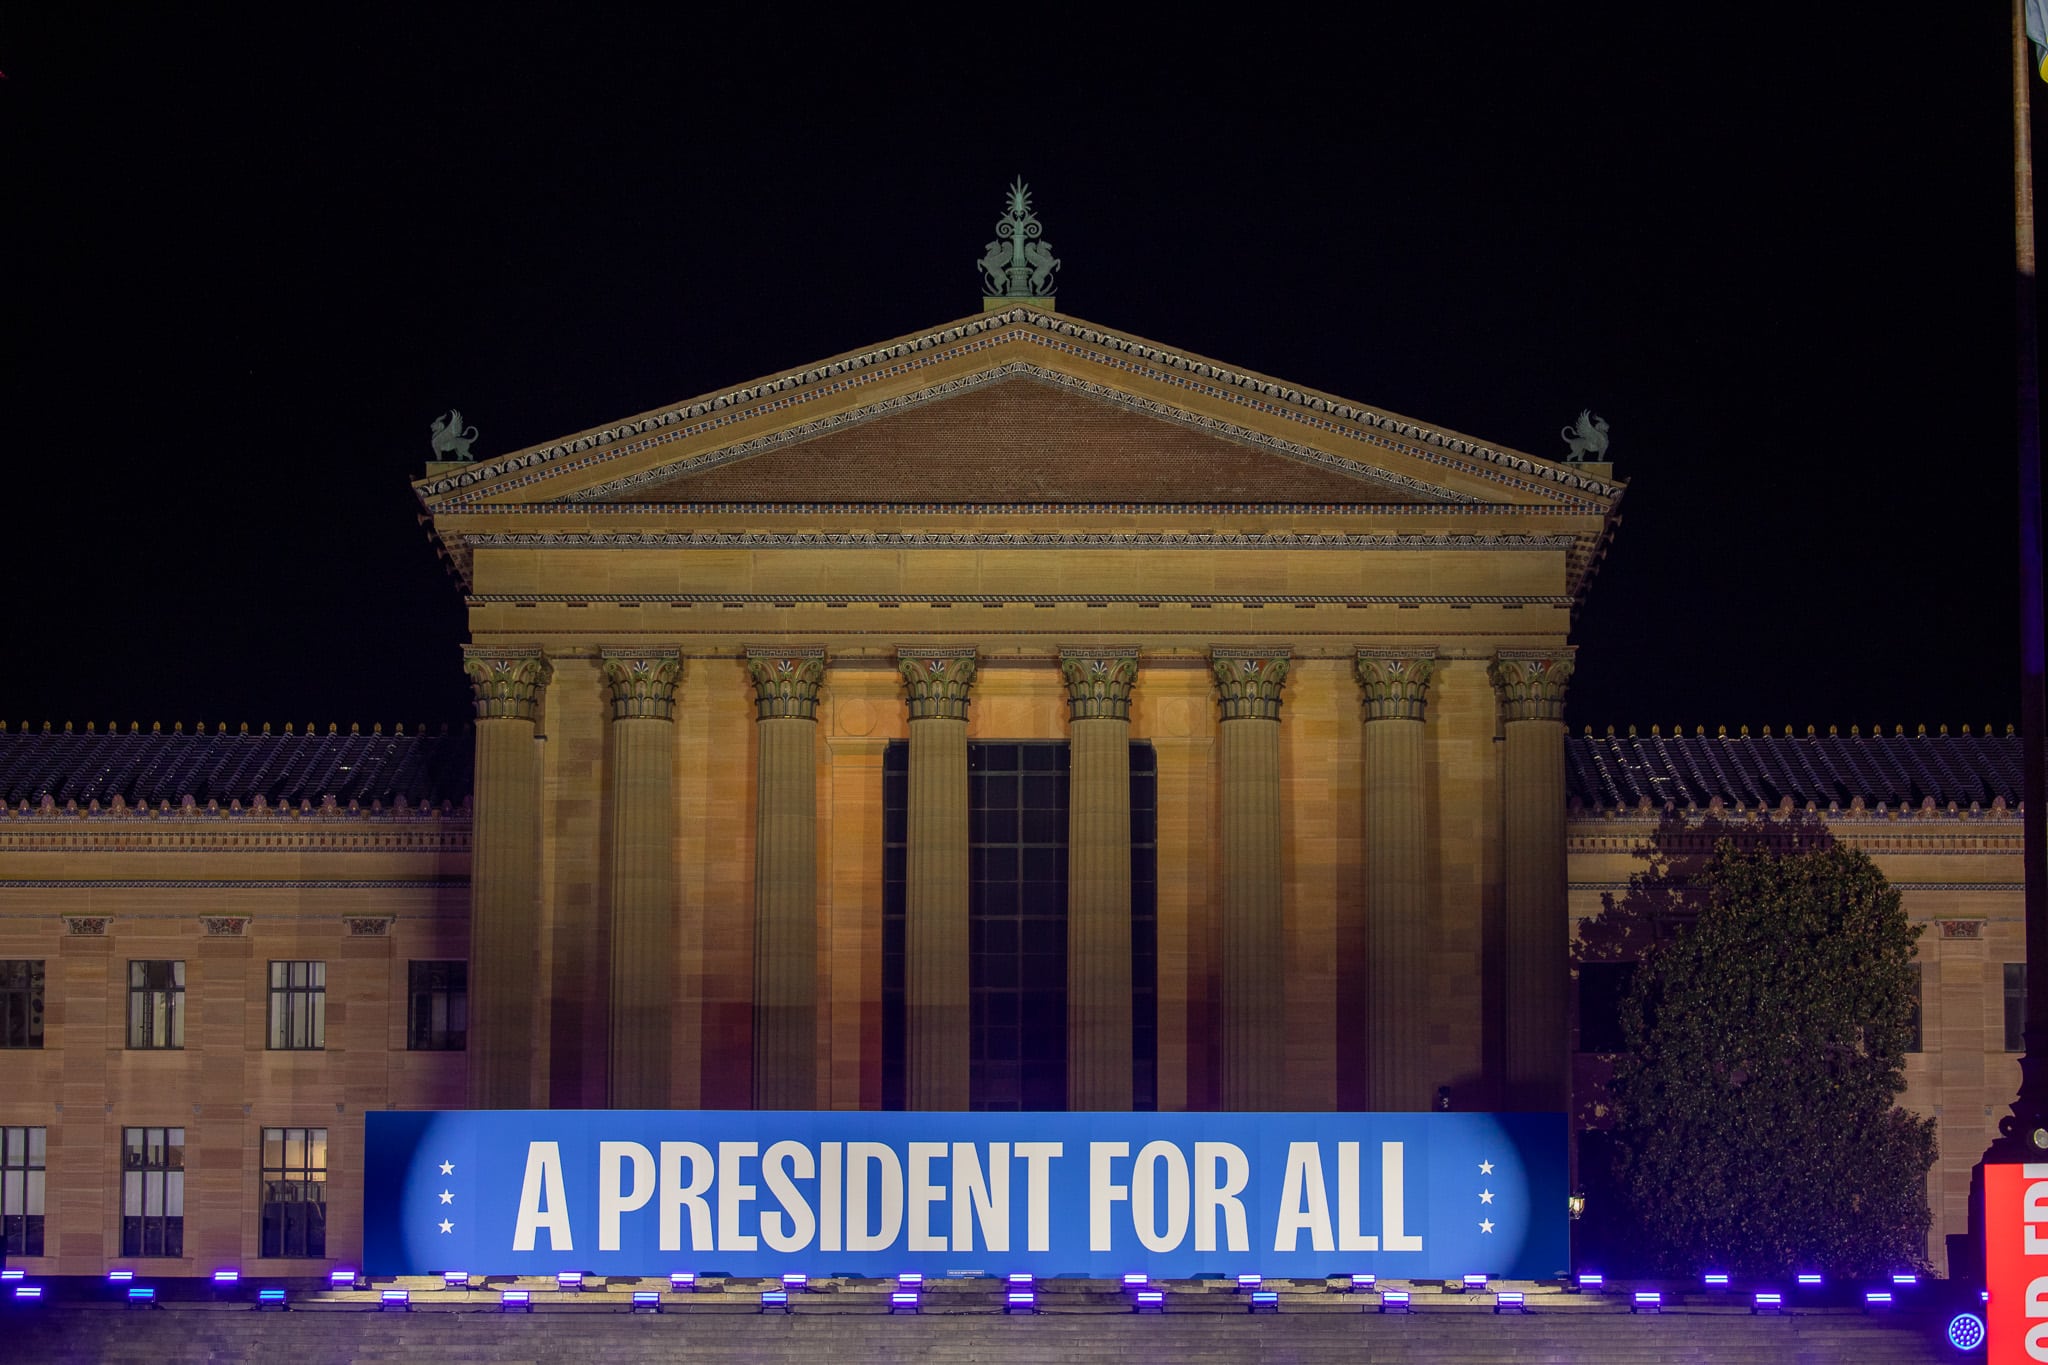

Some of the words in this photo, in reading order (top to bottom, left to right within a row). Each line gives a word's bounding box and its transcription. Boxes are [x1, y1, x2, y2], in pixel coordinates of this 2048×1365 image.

[512, 1141, 574, 1251] A
[598, 1140, 1063, 1253] PRESIDENT
[1089, 1140, 1250, 1253] FOR
[1273, 1141, 1423, 1252] ALL
